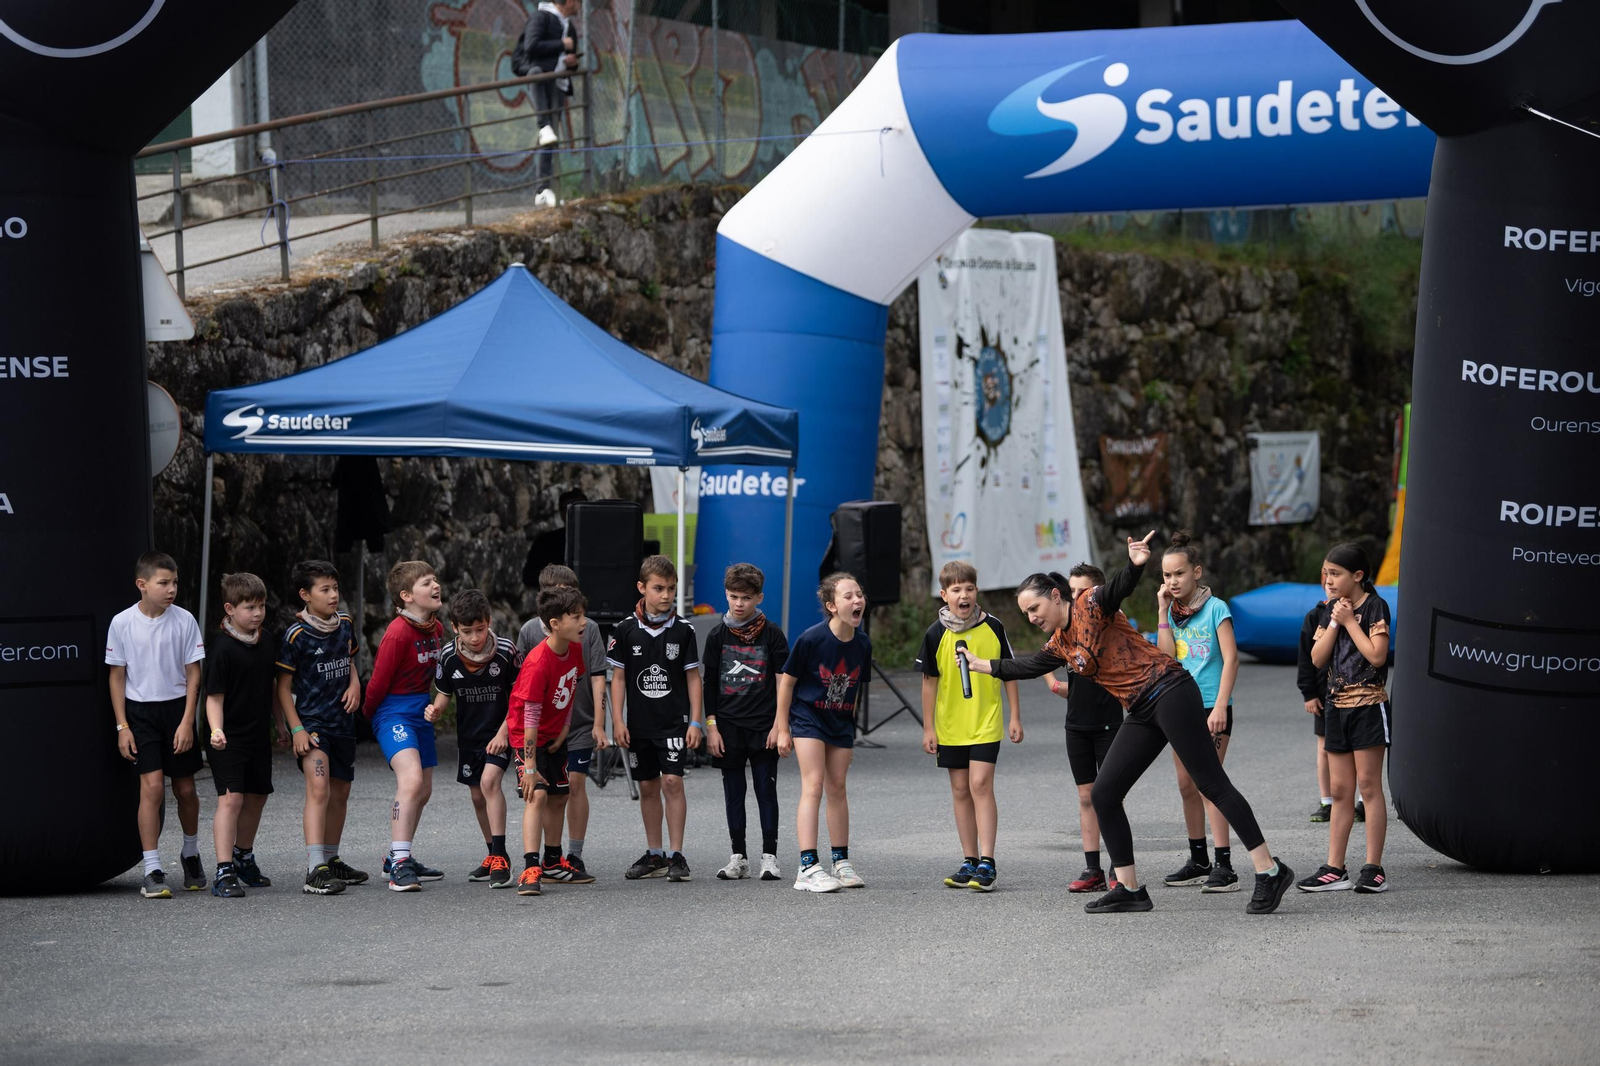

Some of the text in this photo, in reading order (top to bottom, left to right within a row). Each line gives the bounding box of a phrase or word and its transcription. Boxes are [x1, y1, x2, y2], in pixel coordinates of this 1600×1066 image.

[1134, 78, 1421, 145] Saudete
[0, 216, 28, 239] O
[267, 413, 353, 431] Saudeter
[1530, 416, 1600, 433] Ourens
[700, 469, 806, 498] Saudeter
[1500, 500, 1600, 528] ROIPE
[1172, 624, 1212, 639] ennis
[0, 642, 79, 661] er.com
[1449, 642, 1600, 674] www.gruporo
[457, 685, 502, 697] Emirates
[643, 681, 667, 690] Galicia
[466, 694, 475, 703] FLY
[315, 765, 325, 776] 55
